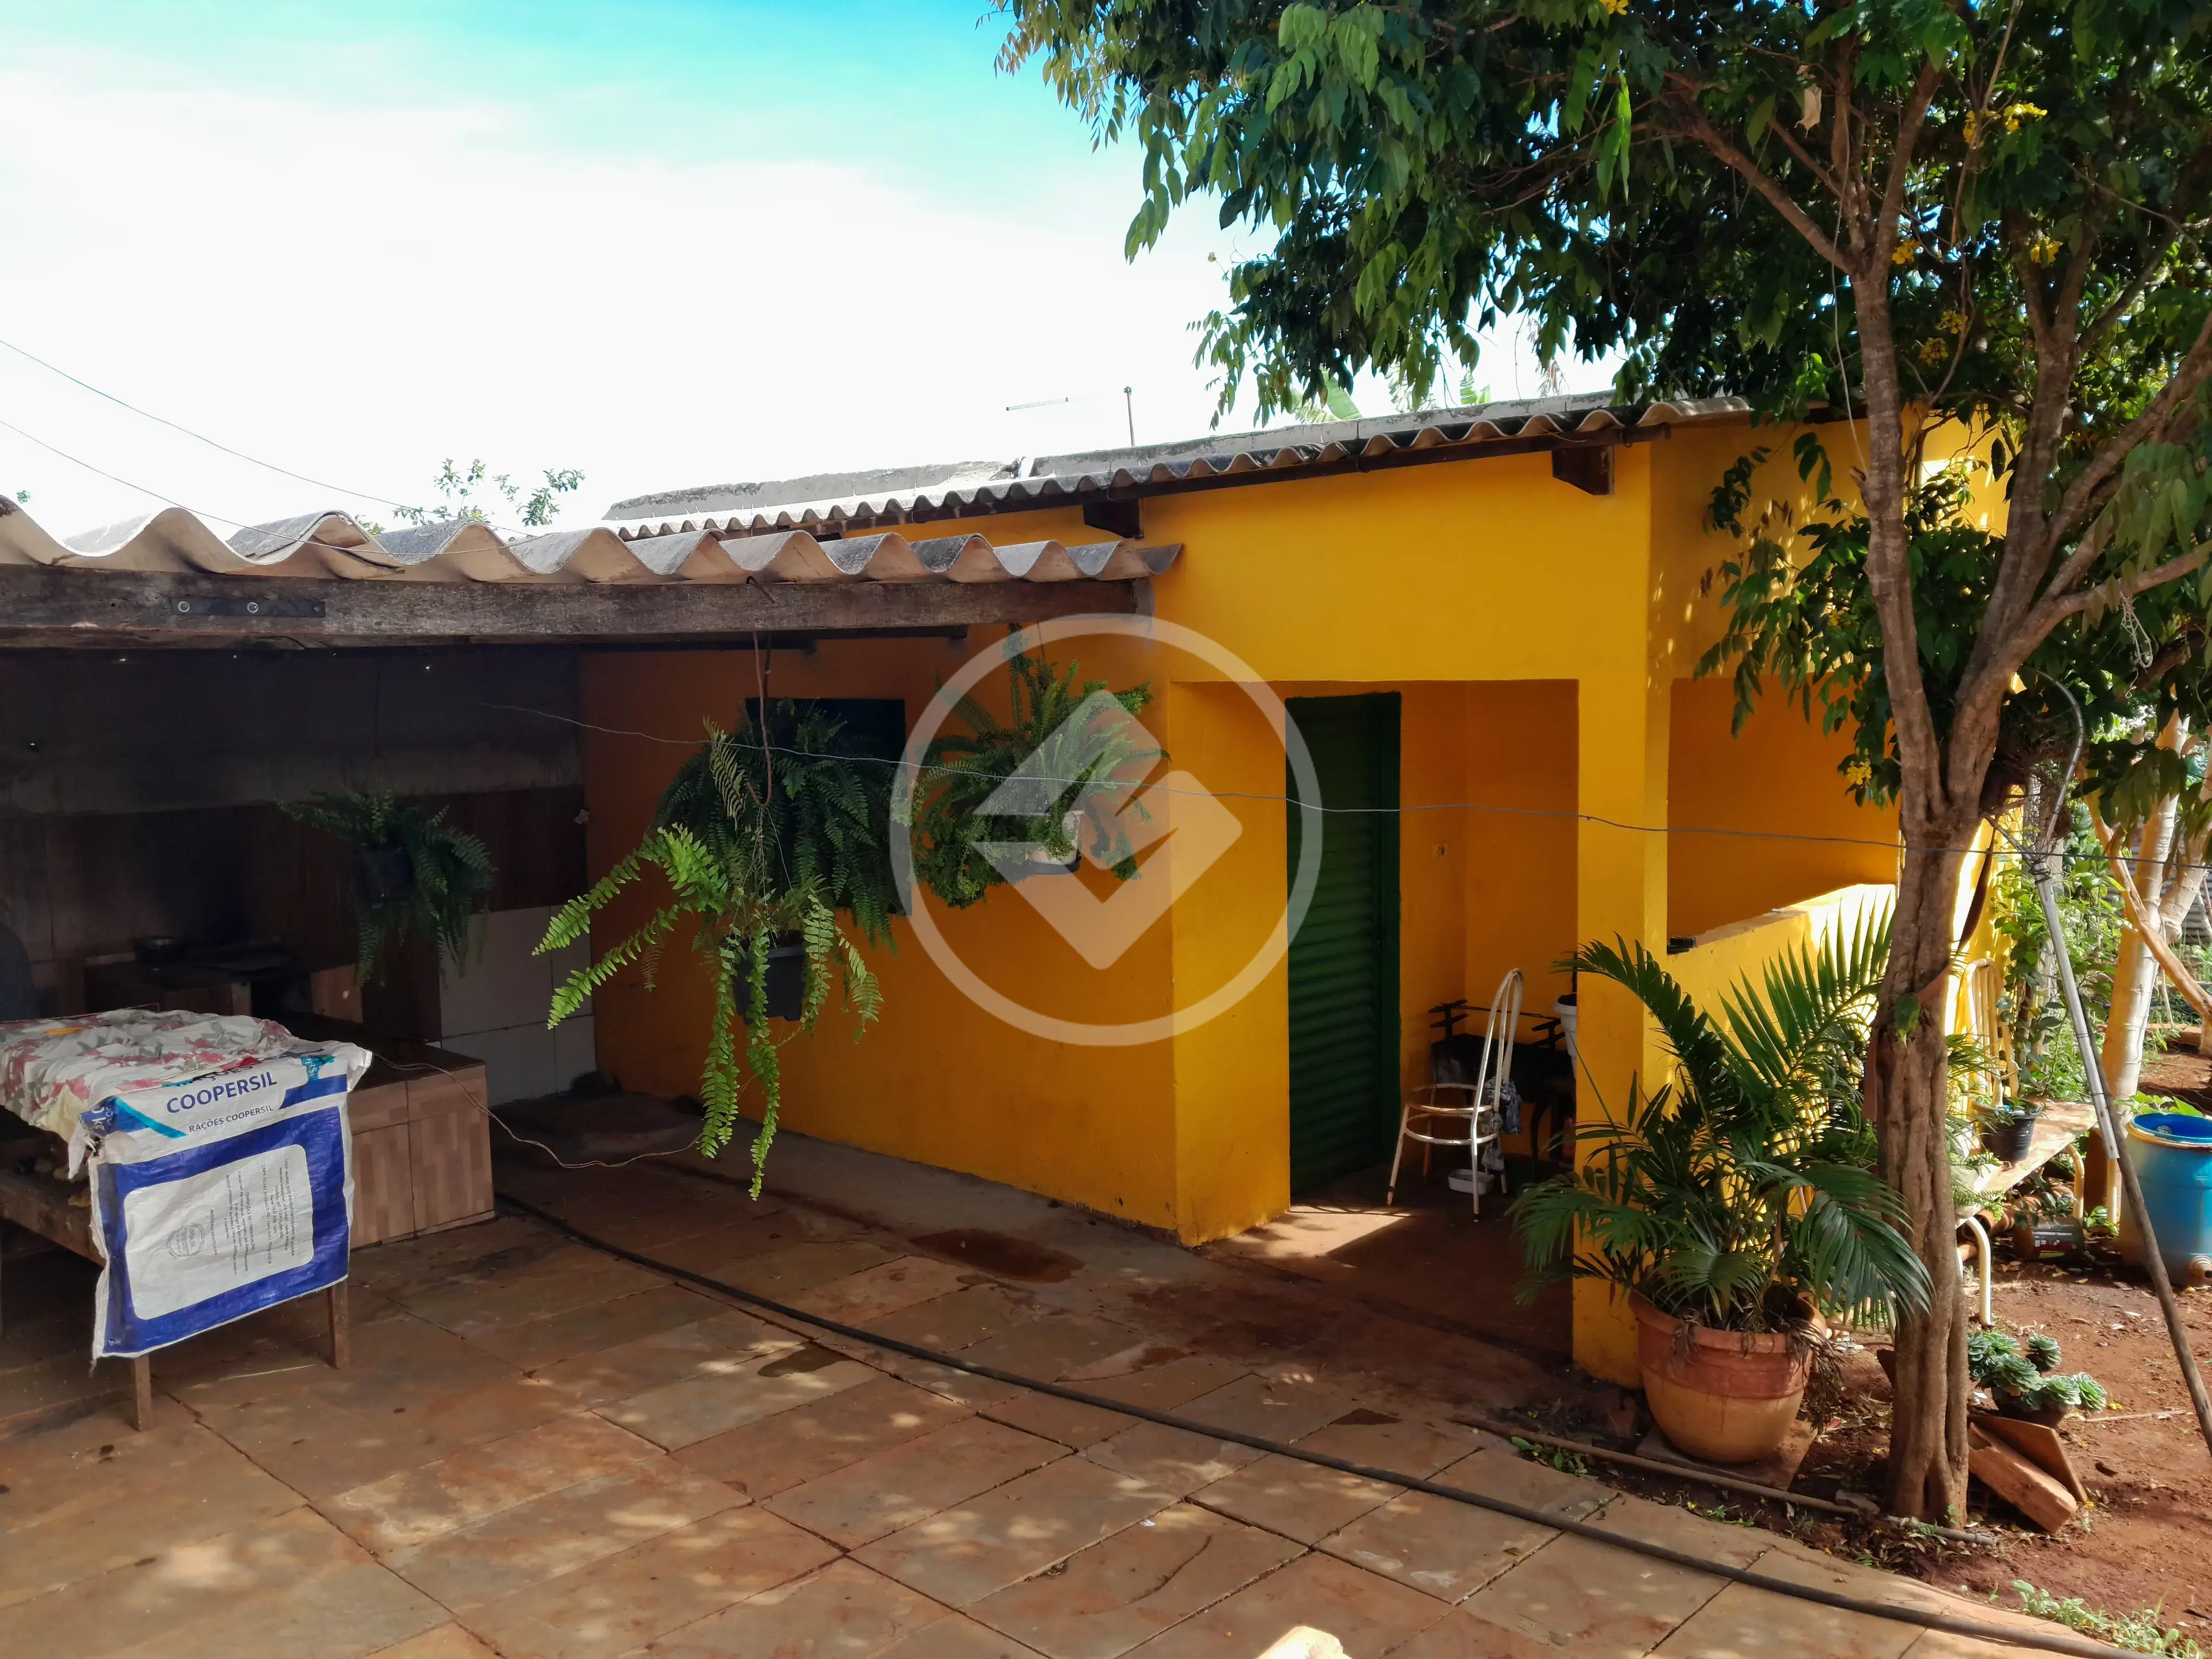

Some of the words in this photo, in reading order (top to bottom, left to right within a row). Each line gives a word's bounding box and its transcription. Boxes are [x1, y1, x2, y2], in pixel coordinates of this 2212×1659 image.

[166, 1071, 278, 1114] COOPERSIL
[189, 1118, 224, 1134] RAÇÕES
[226, 1105, 274, 1123] COOPERSIL
